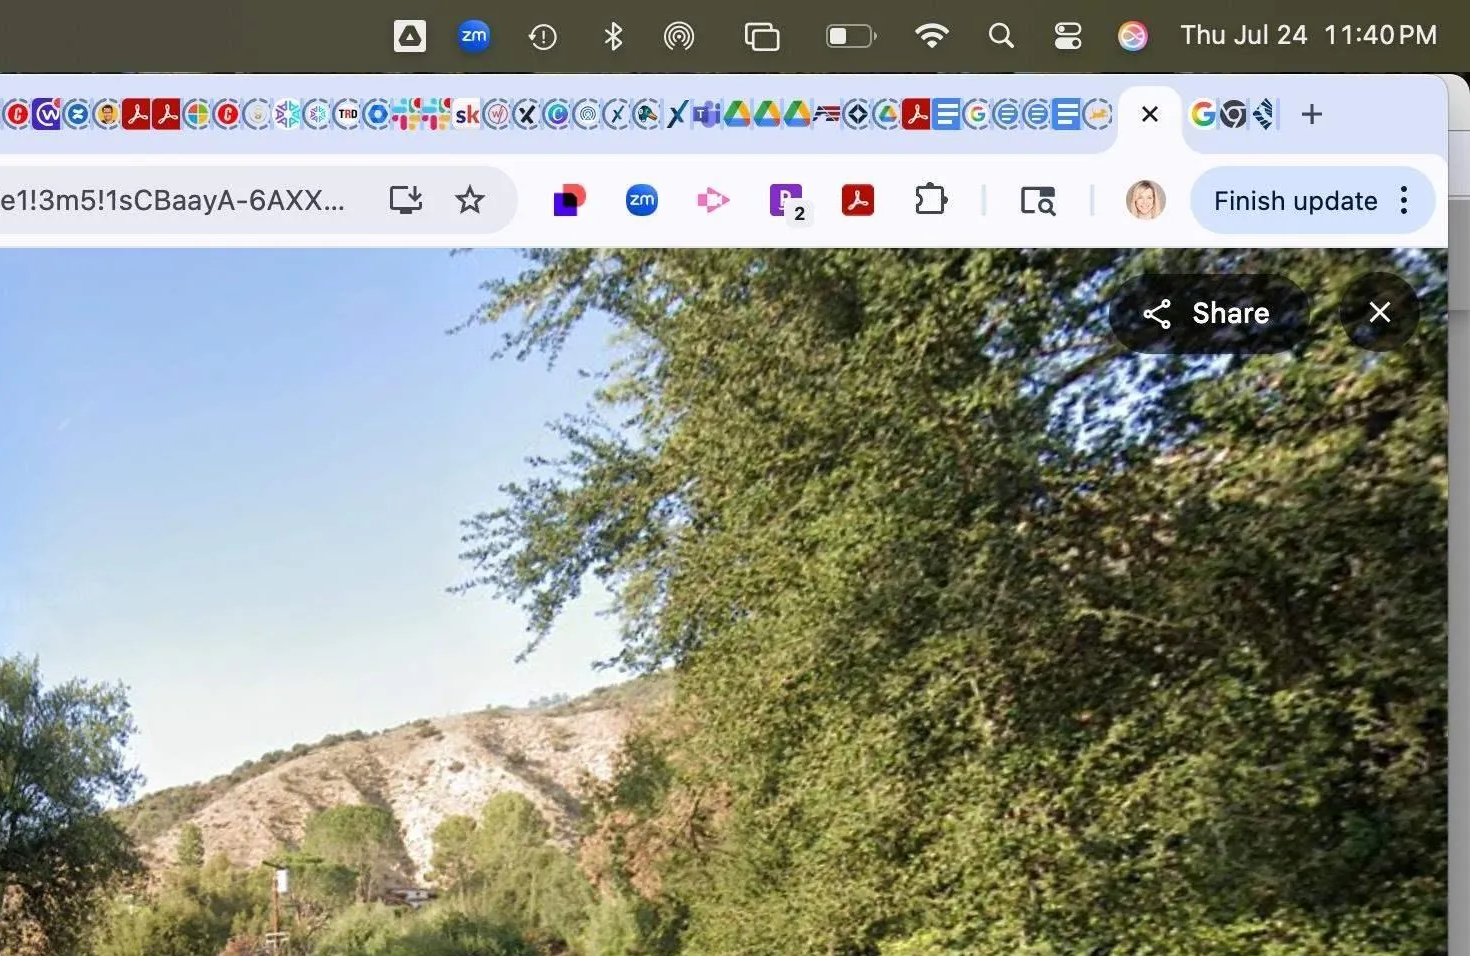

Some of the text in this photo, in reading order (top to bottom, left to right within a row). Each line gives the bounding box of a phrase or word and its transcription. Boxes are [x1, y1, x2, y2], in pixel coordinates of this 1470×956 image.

[461, 29, 487, 43] zm
[1180, 23, 1226, 45] Thu
[1233, 23, 1268, 46] Jul
[1277, 23, 1308, 45] 24
[1399, 24, 1437, 45] PM
[338, 108, 358, 119] TRD
[455, 104, 480, 124] sk
[630, 194, 655, 206] zm
[1215, 189, 1378, 216] Finish update
[794, 206, 805, 221] 2
[1192, 301, 1270, 324] Share
